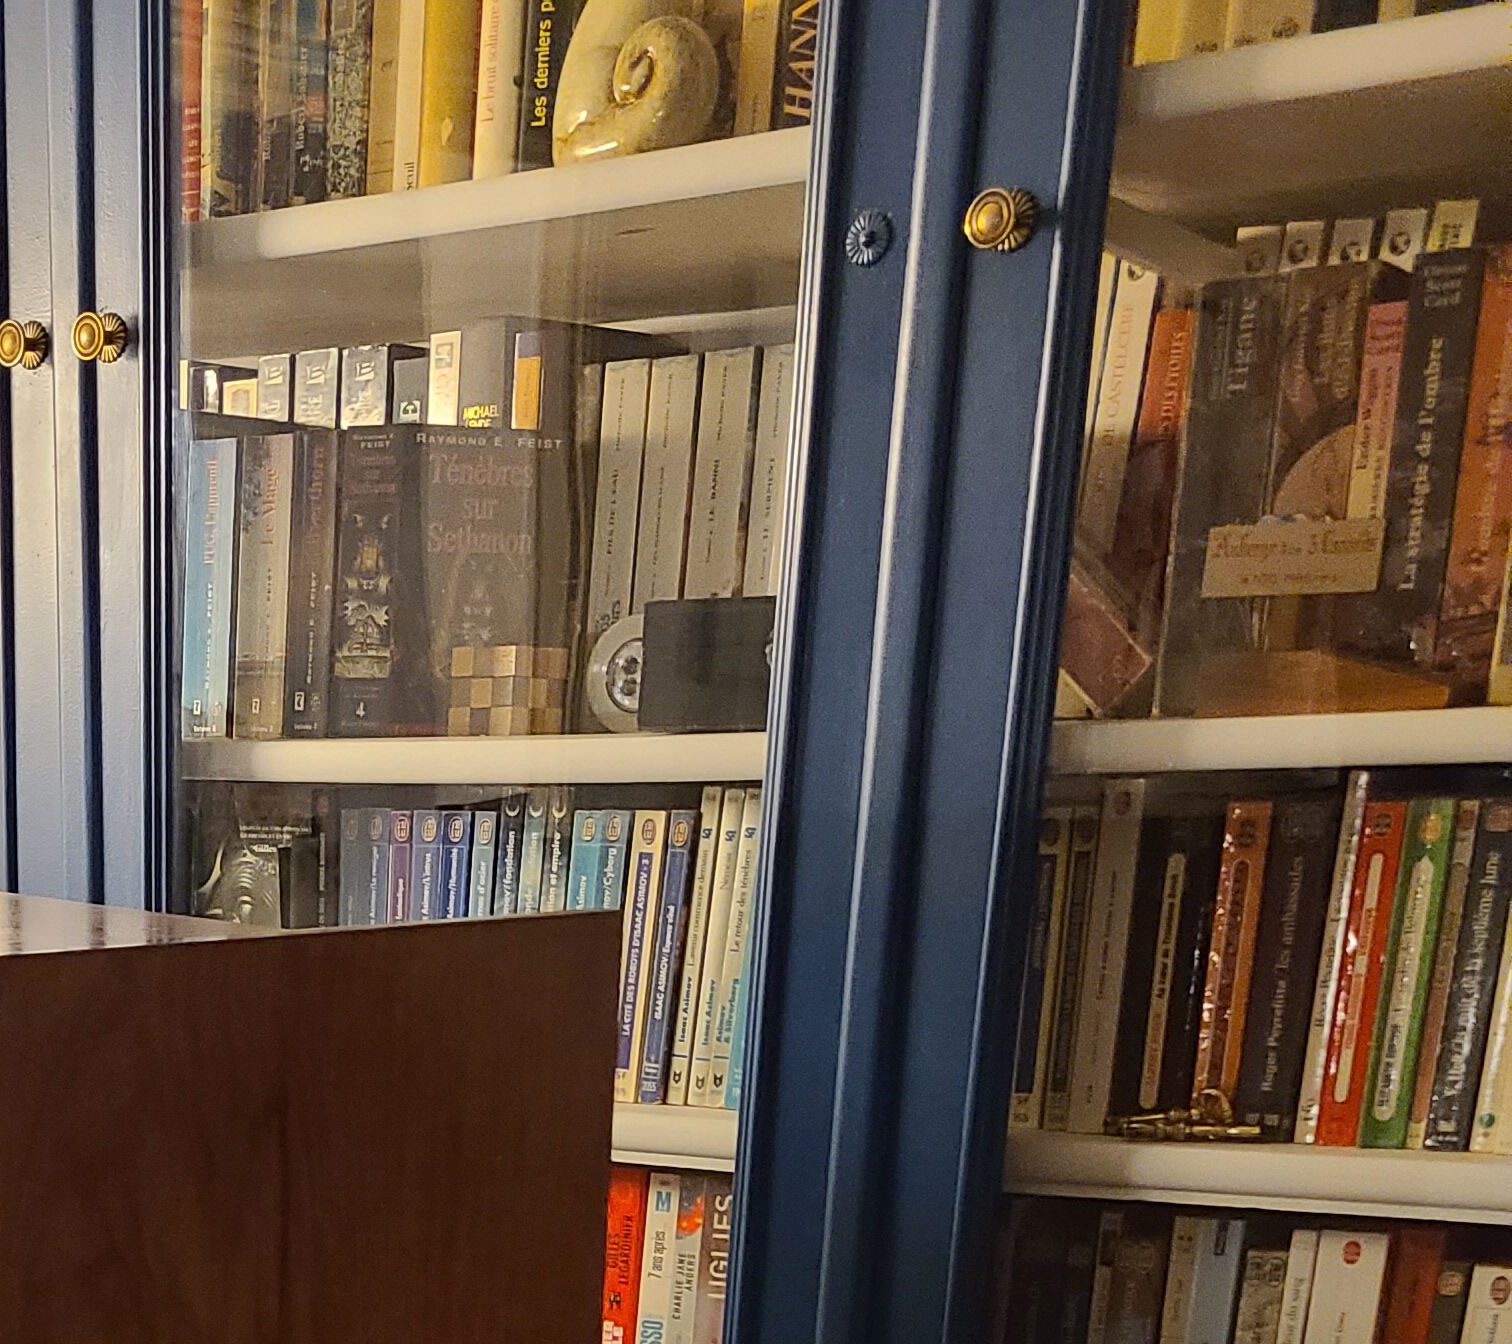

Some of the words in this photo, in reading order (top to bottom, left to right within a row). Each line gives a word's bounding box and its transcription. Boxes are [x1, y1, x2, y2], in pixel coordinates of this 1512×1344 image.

[484, 6, 501, 63] solitaire
[533, 19, 553, 89] derniers
[782, 0, 819, 118] HANN
[482, 66, 499, 100] bruit
[294, 108, 307, 150] Robert
[481, 101, 496, 123] Le
[530, 96, 548, 127] Les
[1227, 297, 1259, 394] Tigane
[1416, 336, 1445, 424] l'ombre
[462, 404, 500, 419] MICHAEL
[415, 431, 487, 448] RAYMOND
[516, 437, 564, 451] FEIST
[1415, 430, 1433, 458] de
[428, 452, 535, 488] Ténèbres
[709, 458, 721, 501] BANNI
[261, 467, 279, 518] Mage
[1404, 464, 1433, 559] stratégie
[1399, 562, 1417, 591] La
[548, 830, 563, 872] empire
[695, 849, 709, 882] demain
[737, 848, 753, 889] ténèbres
[474, 860, 487, 895] d'acier
[501, 830, 517, 914] mov/fondation
[600, 846, 617, 909] mov/Cyborg
[524, 888, 536, 914] onde
[634, 872, 648, 910] ASIMOV
[734, 890, 747, 908] des
[1279, 855, 1304, 945] ambassades
[1466, 889, 1494, 954] septième
[1480, 850, 1502, 885] lune
[629, 910, 644, 947] D'ISAAC
[732, 909, 745, 939] retour
[729, 940, 741, 953] Le
[1274, 948, 1292, 970] les
[626, 947, 640, 984] ROBOTS
[625, 985, 636, 1003] DES
[653, 993, 665, 1021] ISAAC
[680, 975, 694, 1015] Asimov
[703, 978, 717, 1018] Asimov
[622, 1023, 632, 1037] LA
[677, 1016, 688, 1043] Isaac
[700, 1019, 712, 1046] Isaac
[714, 1003, 727, 1043] Asimov
[1260, 1050, 1279, 1091] Roger
[655, 1191, 672, 1213] M
[617, 1215, 635, 1286] LEGARDINIER
[651, 1230, 668, 1255] après
[651, 1255, 664, 1272] ans
[675, 1252, 688, 1277] JANE
[683, 1252, 697, 1292] ANDERS
[671, 1279, 687, 1321] CHARLIE
